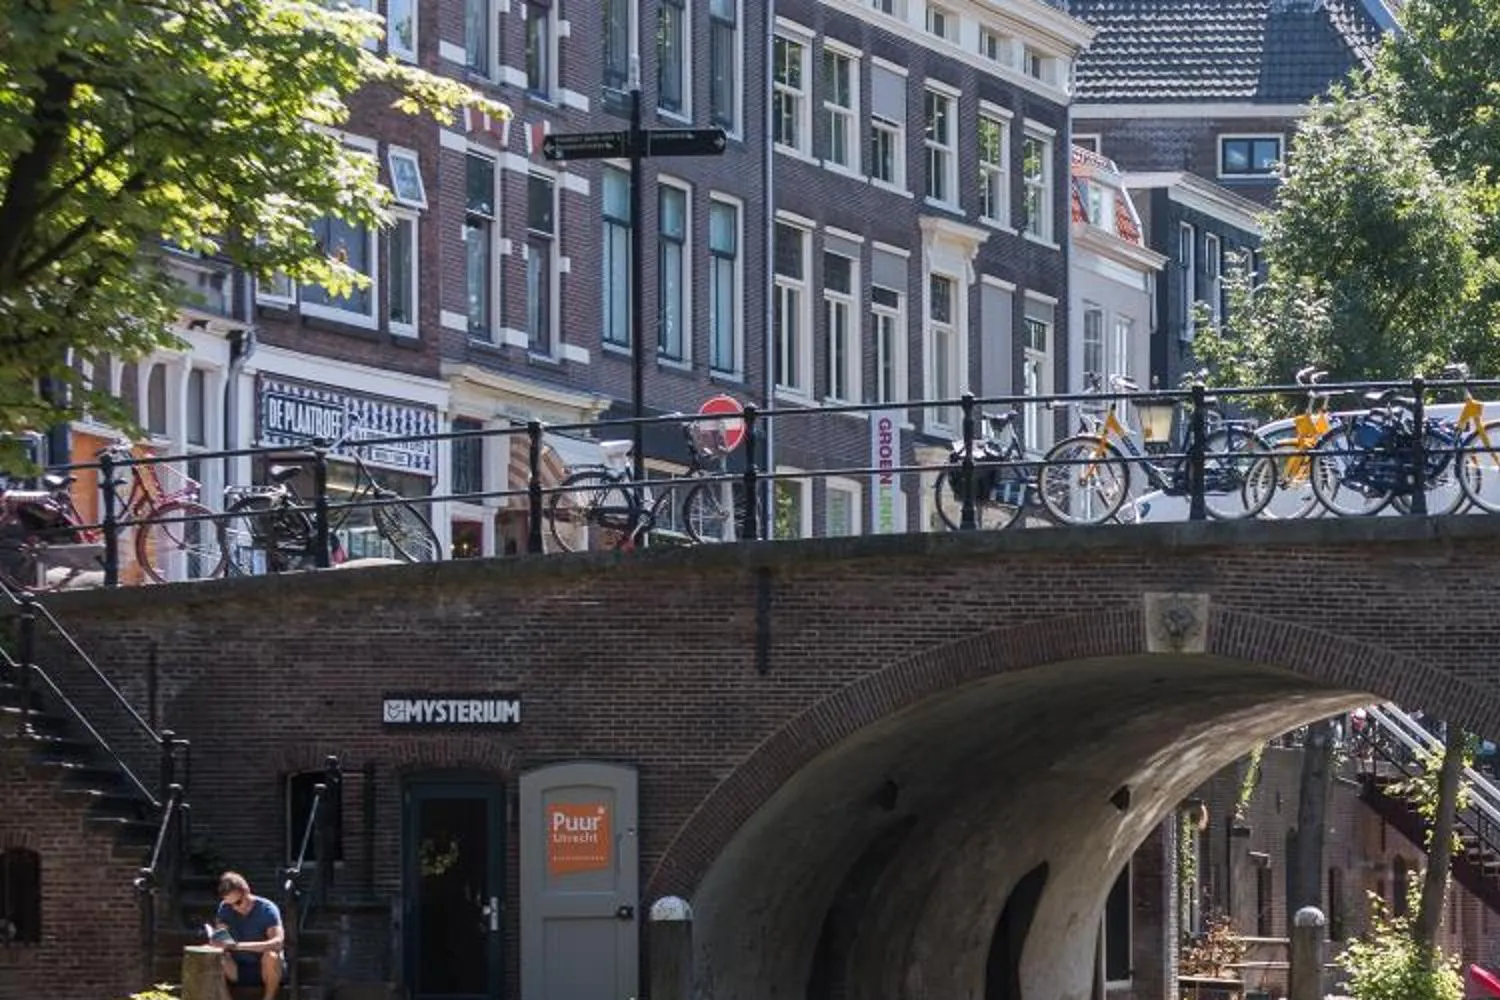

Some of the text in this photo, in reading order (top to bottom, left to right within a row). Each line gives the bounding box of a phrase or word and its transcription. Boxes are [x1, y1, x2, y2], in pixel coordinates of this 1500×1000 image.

[269, 398, 283, 430] DE
[405, 700, 521, 723] MYSTERIUM
[553, 812, 600, 831] Puur
